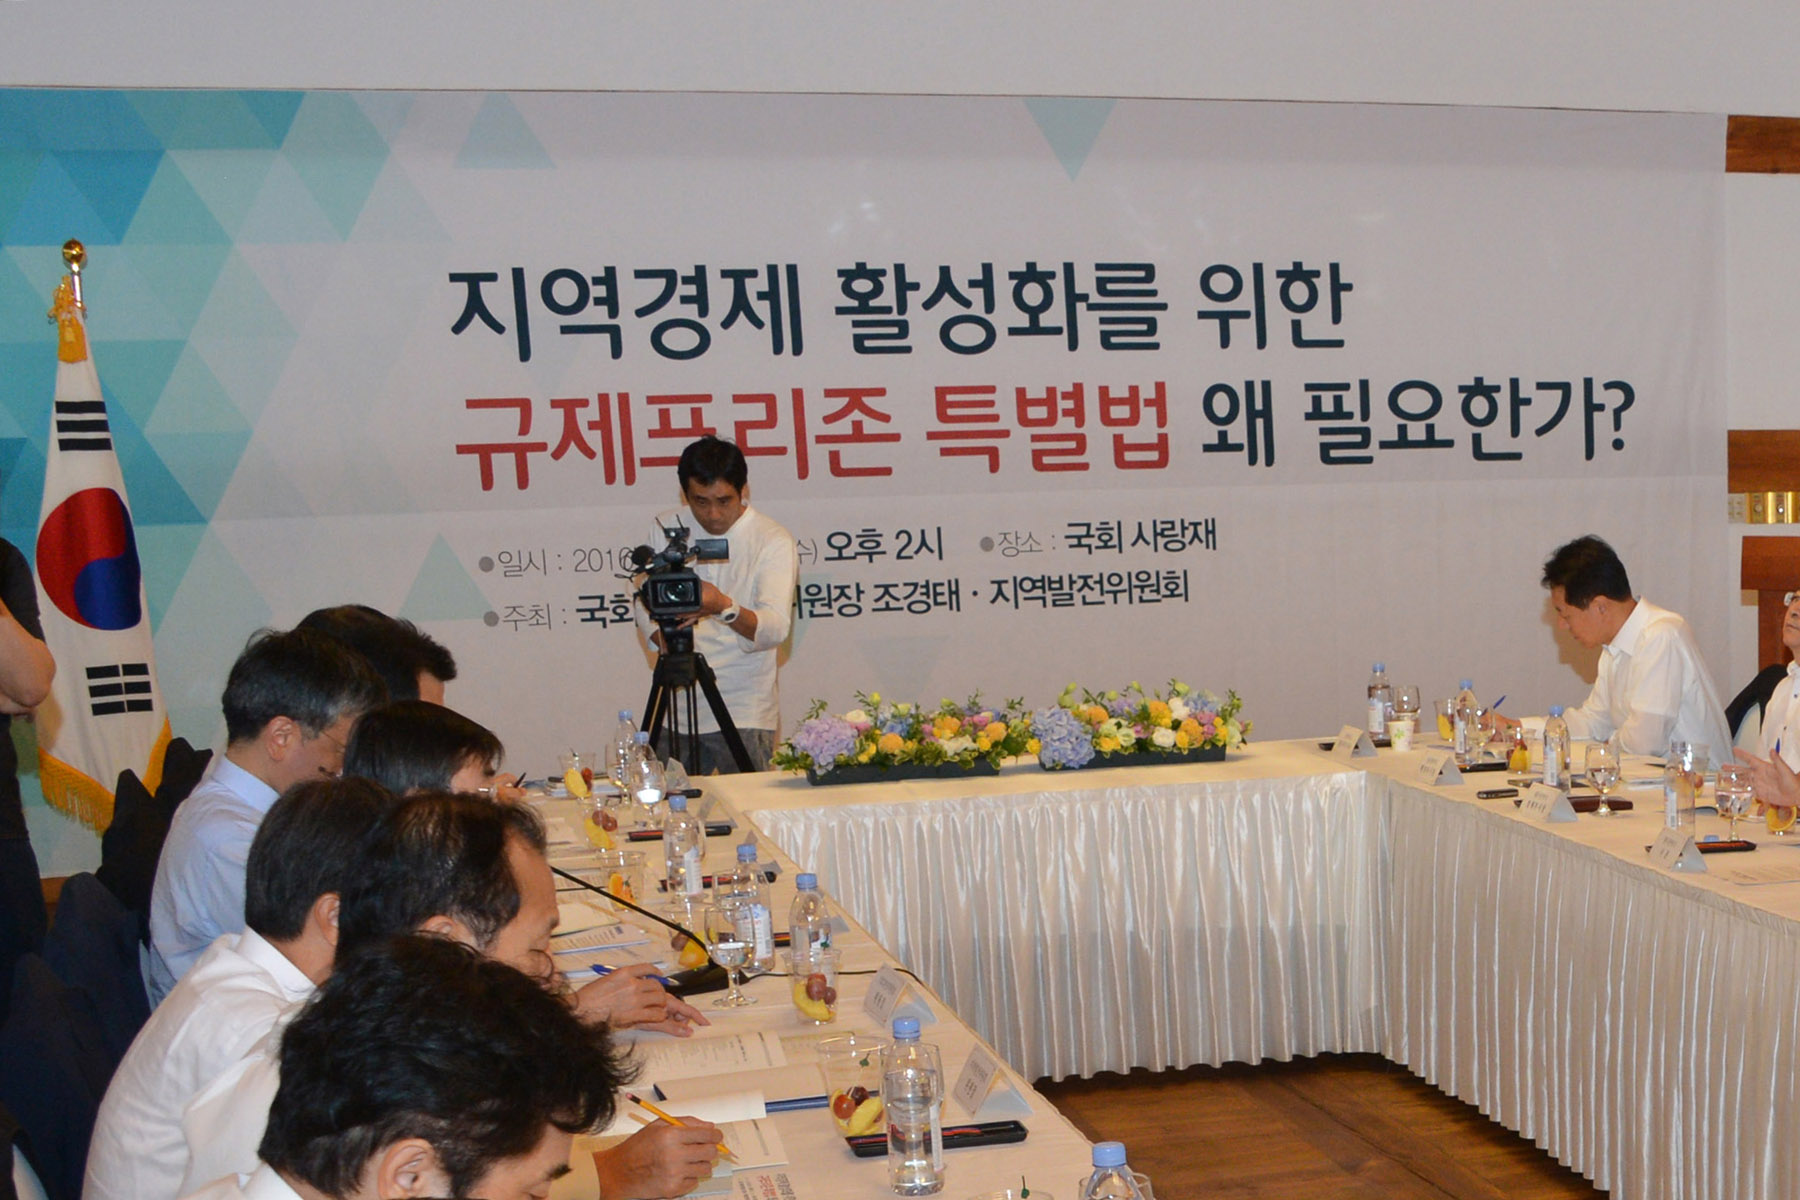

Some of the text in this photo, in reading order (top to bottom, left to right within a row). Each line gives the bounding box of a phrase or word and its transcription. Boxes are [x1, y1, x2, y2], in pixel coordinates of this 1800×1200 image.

[448, 261, 1353, 362] 지역경제 활성화를 위한
[456, 376, 1636, 491] 규제프리존 특별법 왜 필요한가?
[498, 548, 548, 577] 일시
[824, 528, 887, 563] 오후
[895, 526, 943, 560] 2시
[998, 530, 1043, 557] 장소
[1064, 520, 1123, 554] 국회
[1131, 518, 1217, 552] 사랑재
[503, 603, 551, 631] 주최
[872, 578, 961, 614] 조경태
[990, 569, 1189, 609] 지역발전위원회
